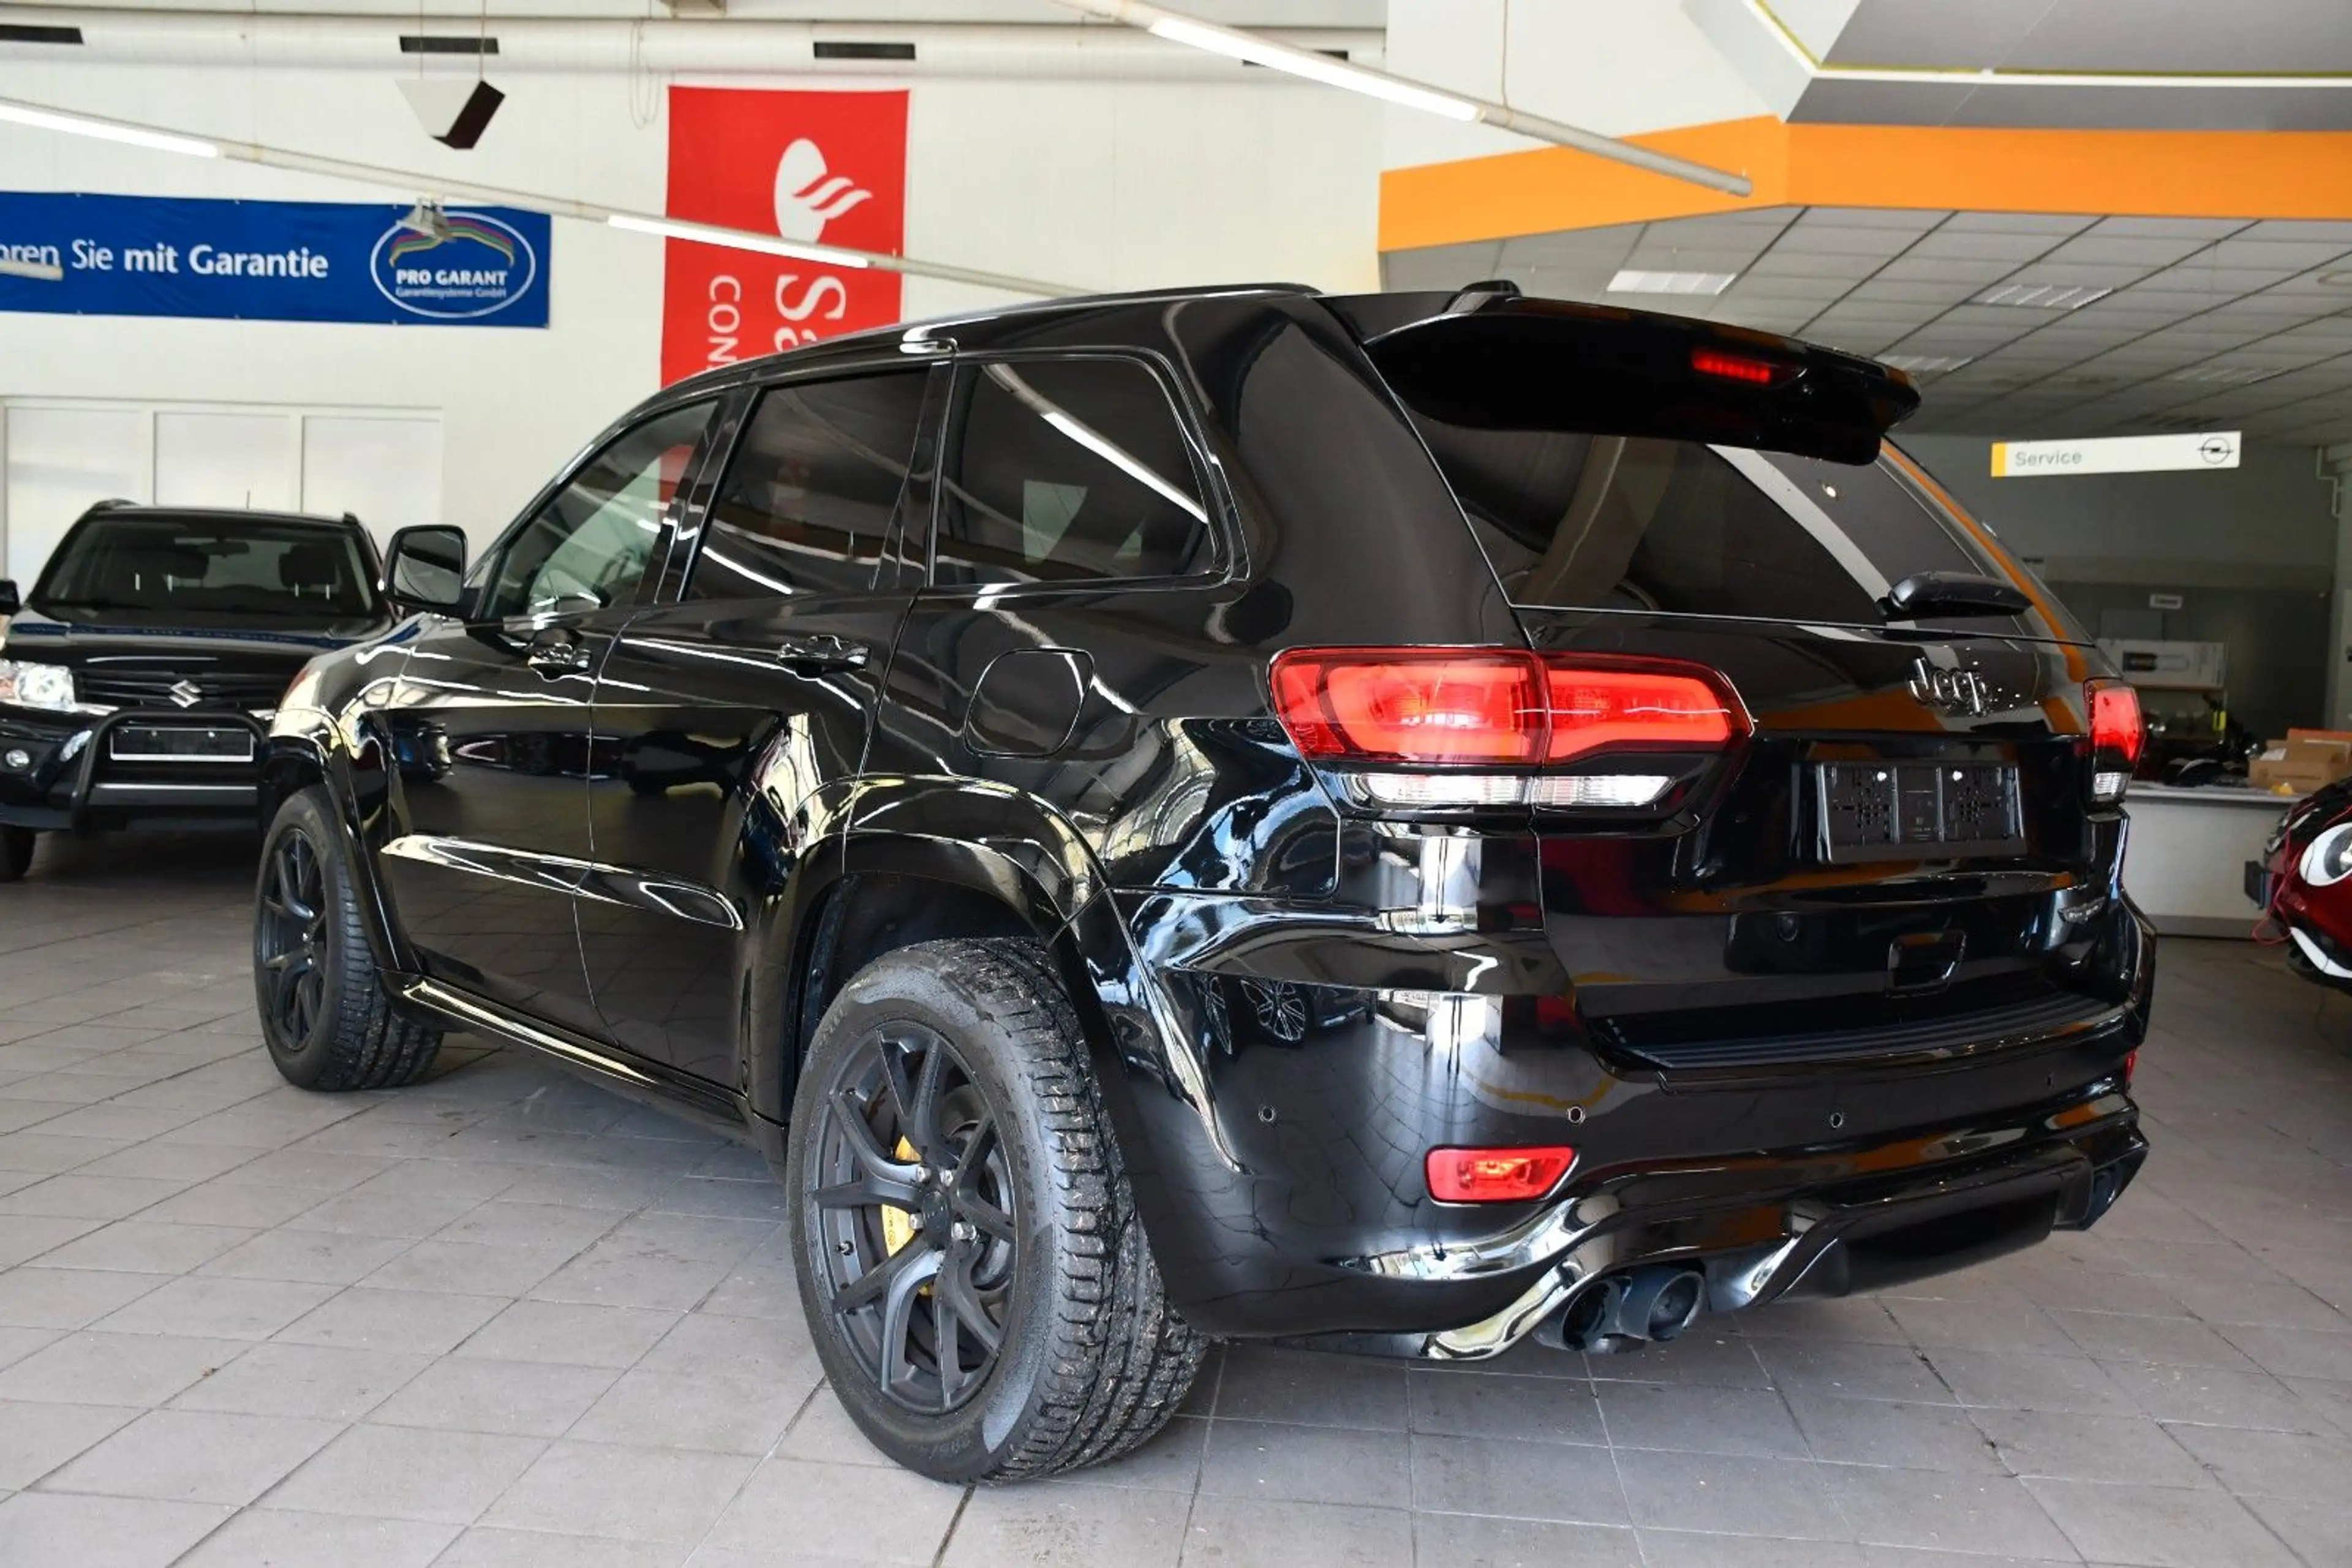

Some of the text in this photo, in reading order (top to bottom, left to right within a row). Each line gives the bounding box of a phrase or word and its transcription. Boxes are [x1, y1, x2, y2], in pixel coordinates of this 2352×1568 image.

[71, 239, 114, 270] Sie
[124, 242, 179, 273] mit
[189, 244, 329, 278] Garantie
[396, 268, 508, 286] PRO GARANT
[2015, 450, 2082, 467] Service
[1908, 657, 1992, 718] Jeep
